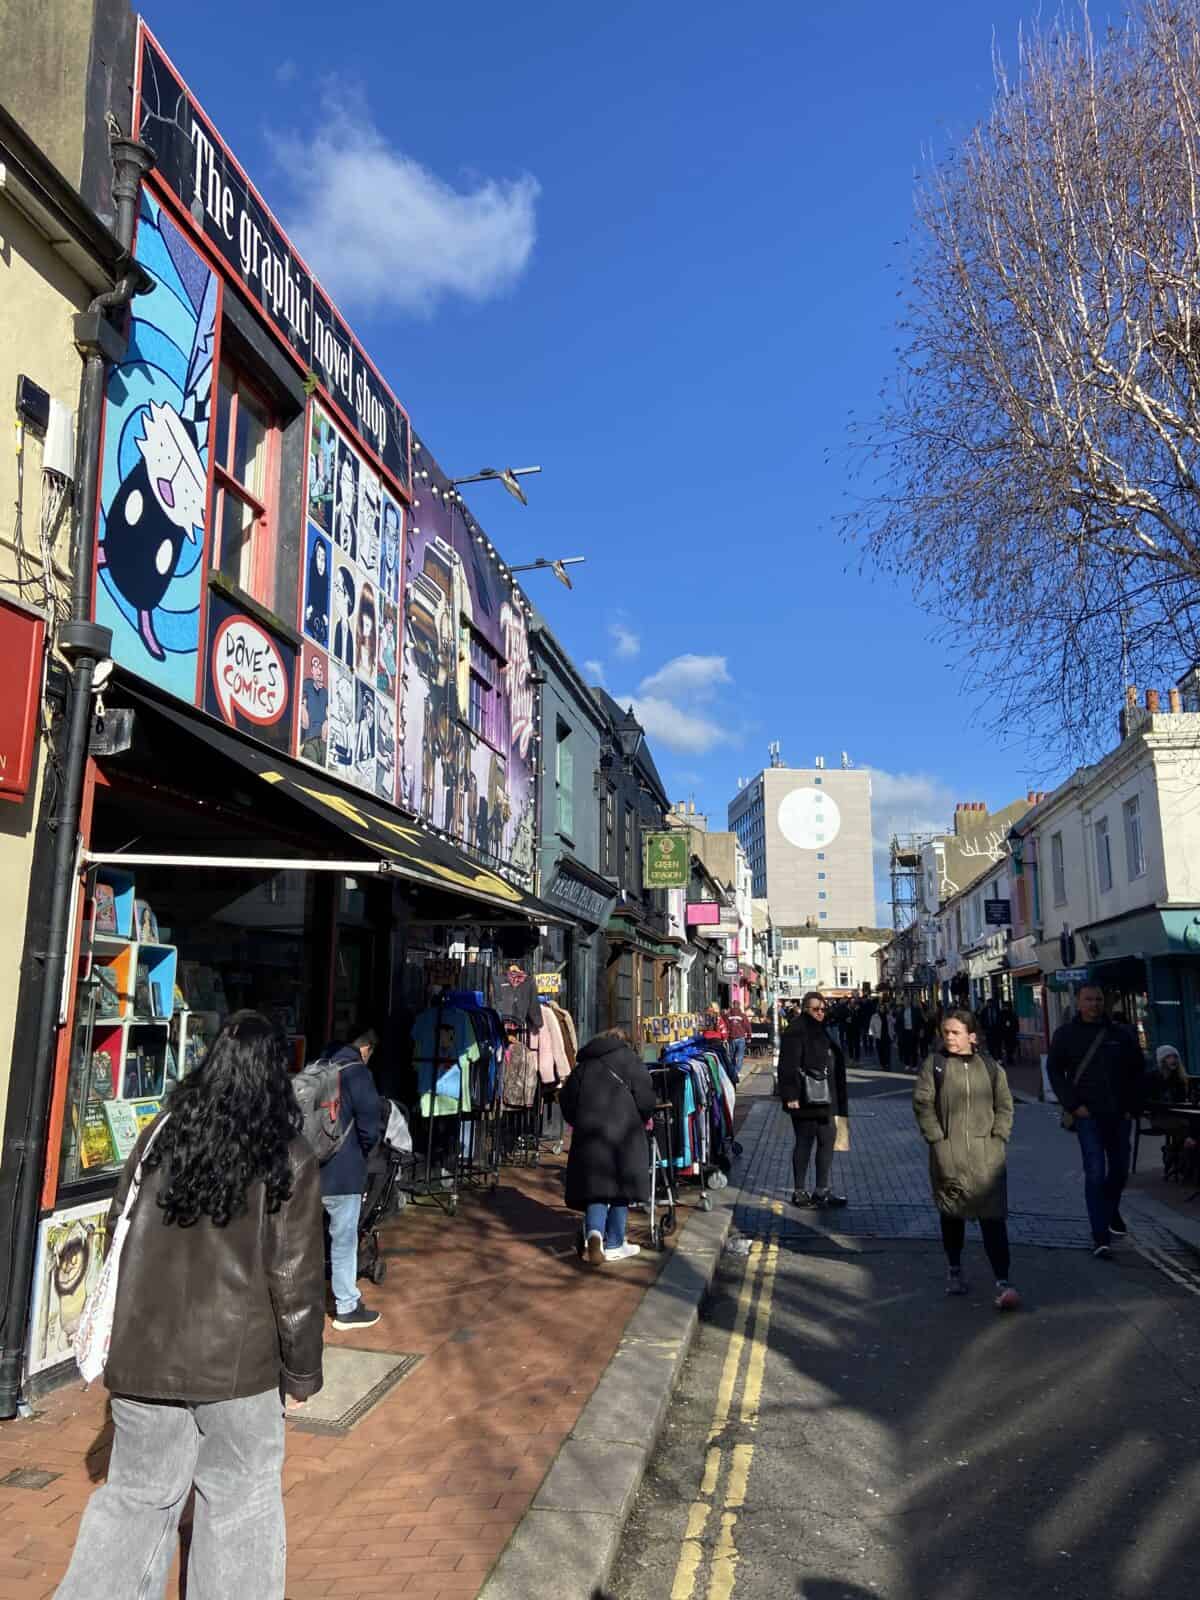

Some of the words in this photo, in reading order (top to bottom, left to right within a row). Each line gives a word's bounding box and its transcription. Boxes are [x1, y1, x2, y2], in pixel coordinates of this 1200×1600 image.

[191, 119, 235, 241] The
[239, 210, 311, 345] graphic
[313, 312, 354, 406] novel
[356, 369, 387, 455] shop
